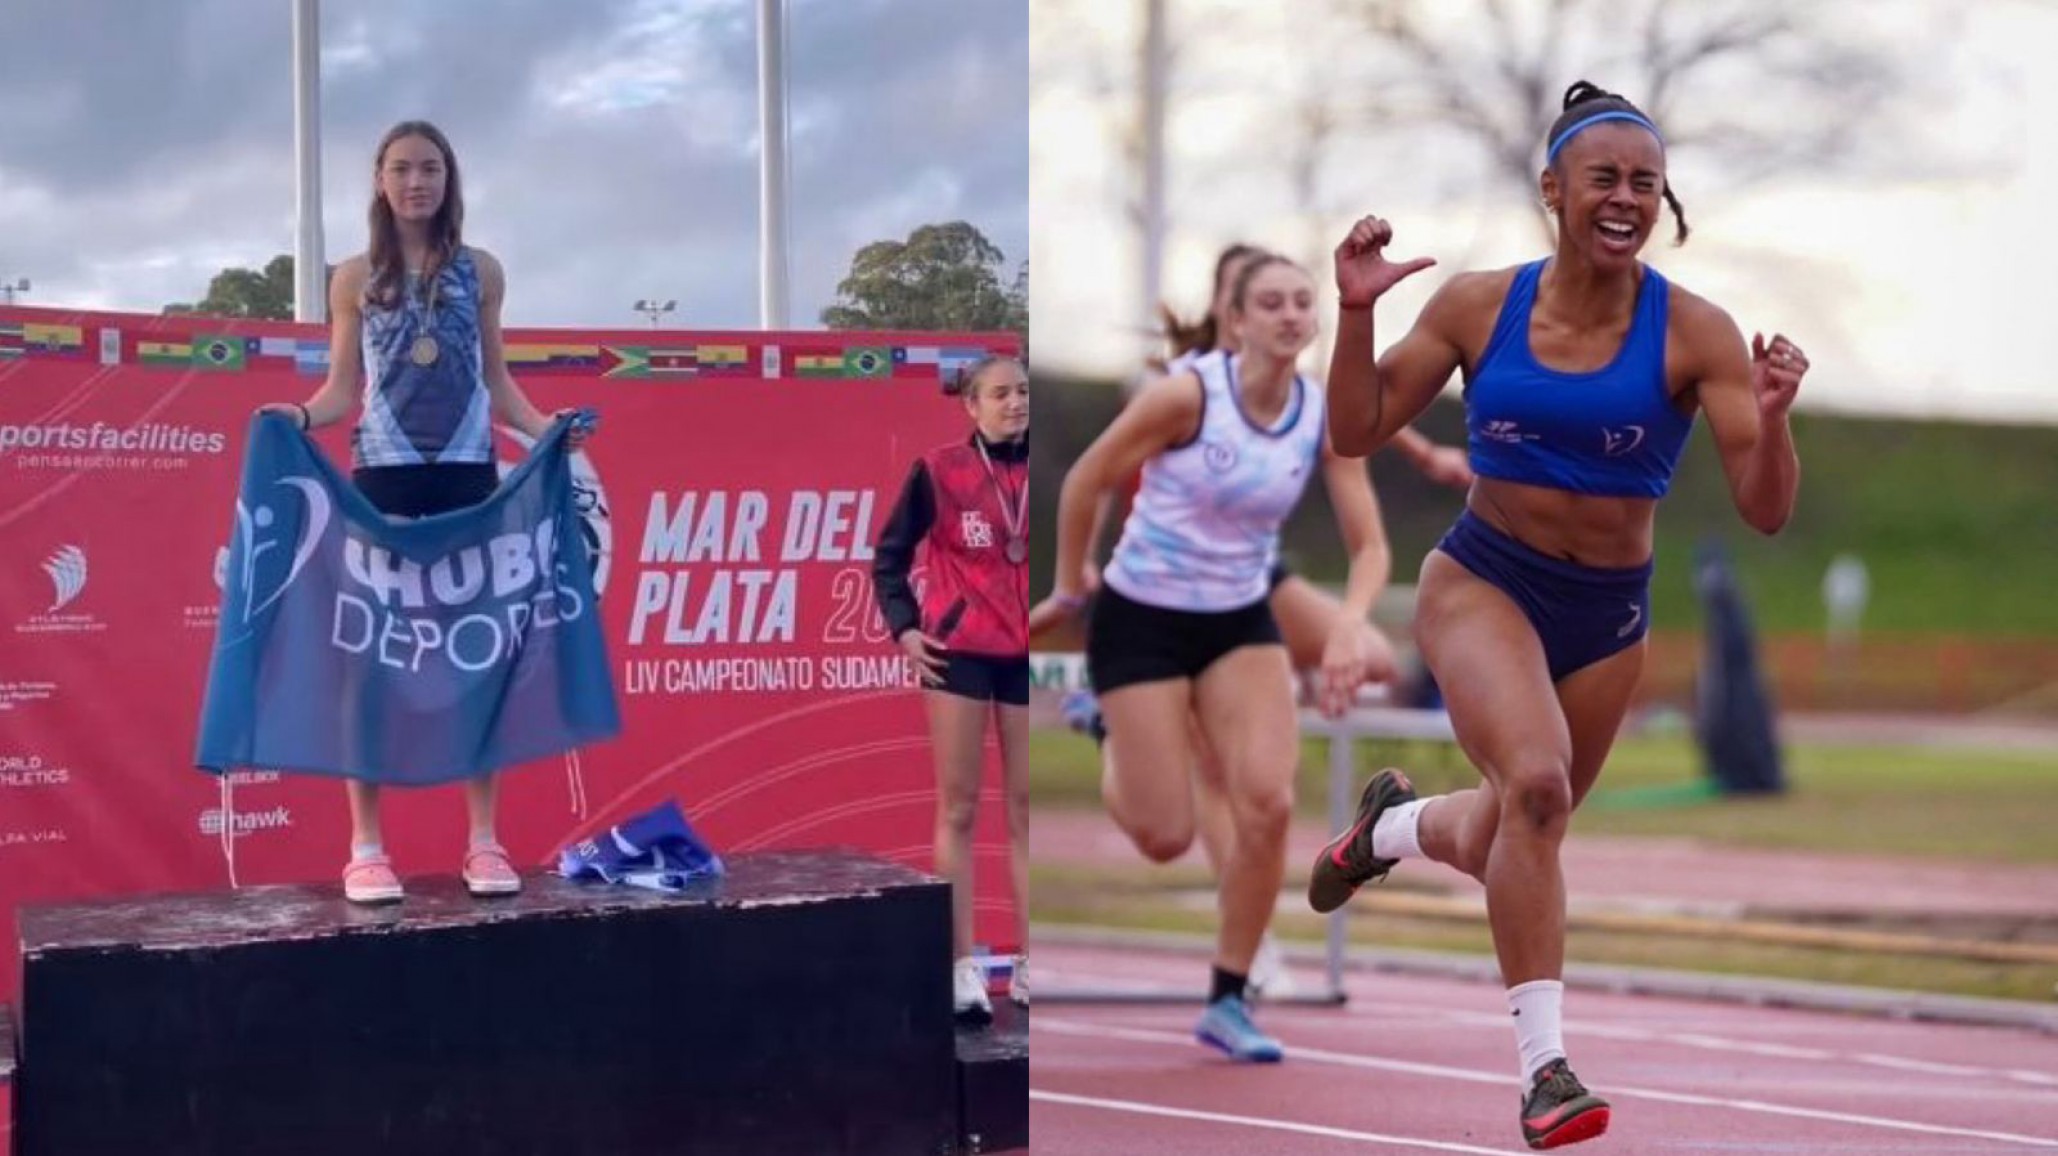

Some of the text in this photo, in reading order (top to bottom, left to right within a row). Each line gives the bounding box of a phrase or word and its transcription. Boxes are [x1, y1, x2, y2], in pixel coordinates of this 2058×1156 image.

[639, 491, 876, 563] MAR DEL
[331, 562, 583, 672] DEPORES
[628, 570, 797, 645] PLATA
[625, 655, 921, 694] LIV CAMPEONATO SUDAME
[0, 769, 70, 787] HLETICS
